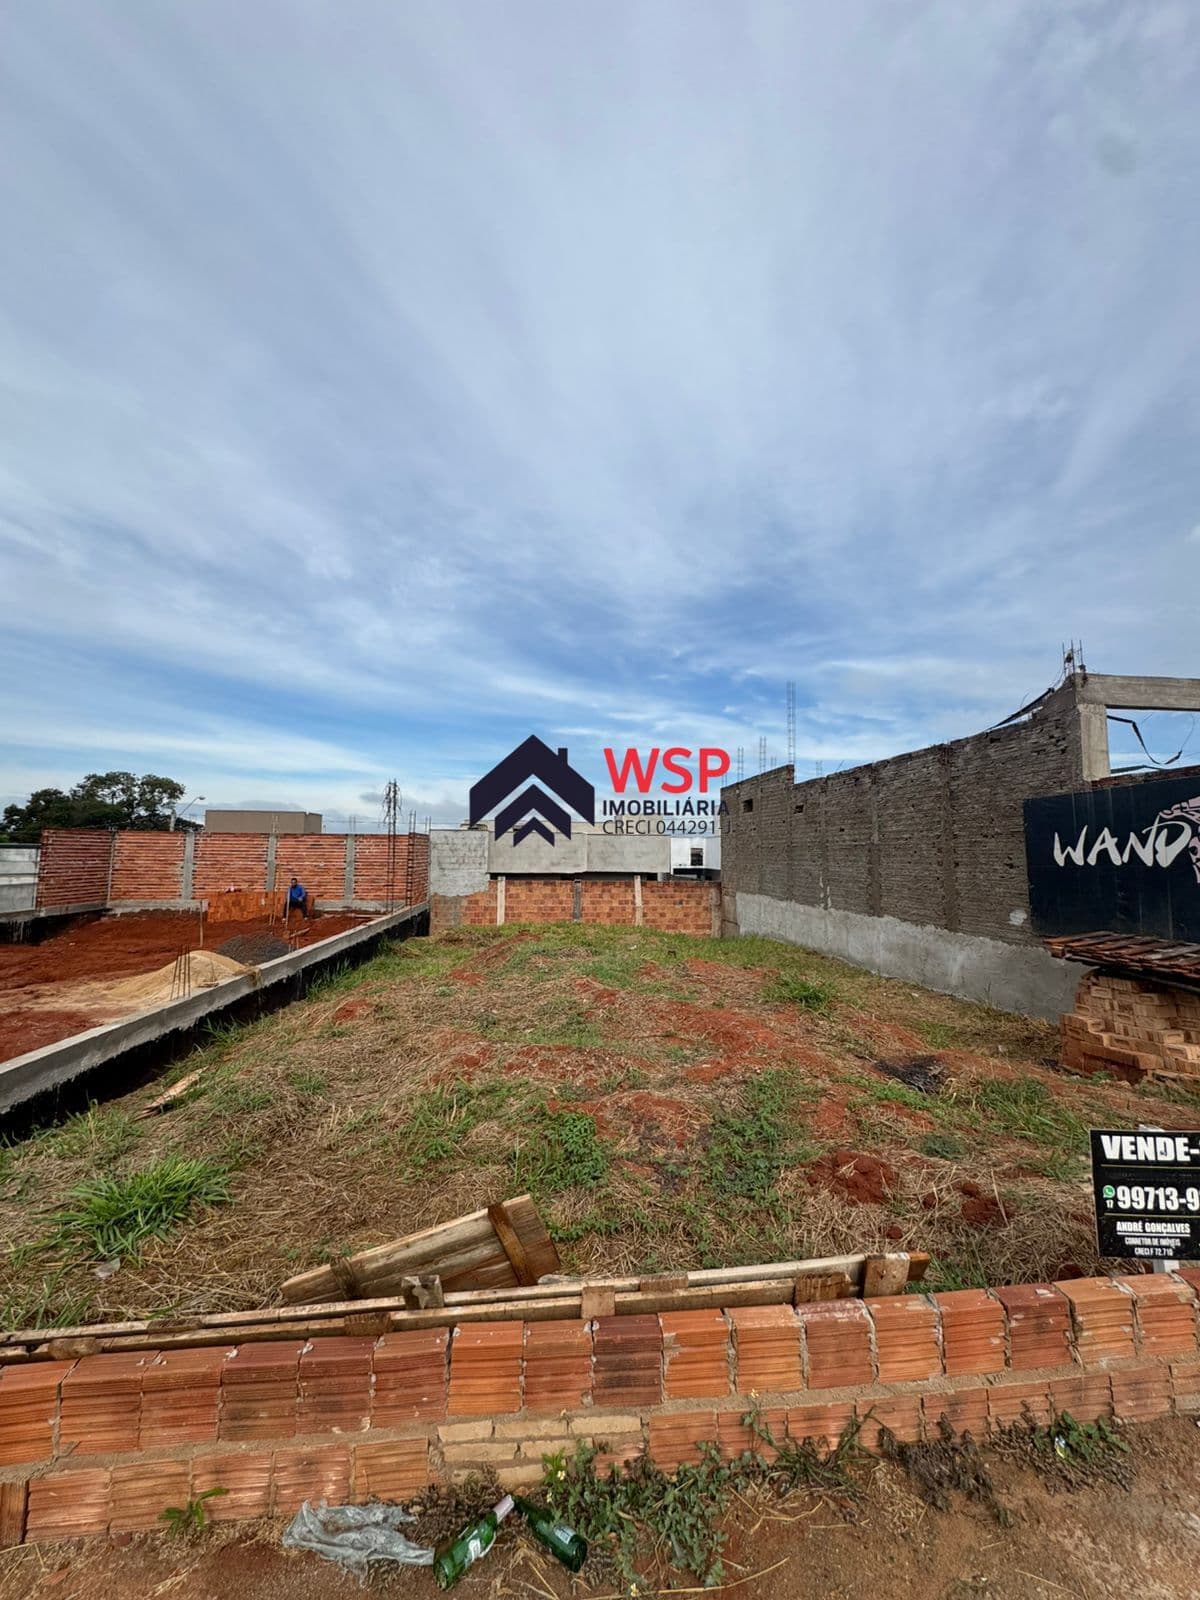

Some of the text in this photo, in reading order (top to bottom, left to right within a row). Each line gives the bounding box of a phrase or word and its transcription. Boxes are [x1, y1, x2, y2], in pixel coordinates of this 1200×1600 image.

[1100, 1135, 1200, 1162] VENDE-
[1116, 1185, 1200, 1211] 99713-9
[1116, 1220, 1191, 1235] ANDRÉ GONÇALVES
